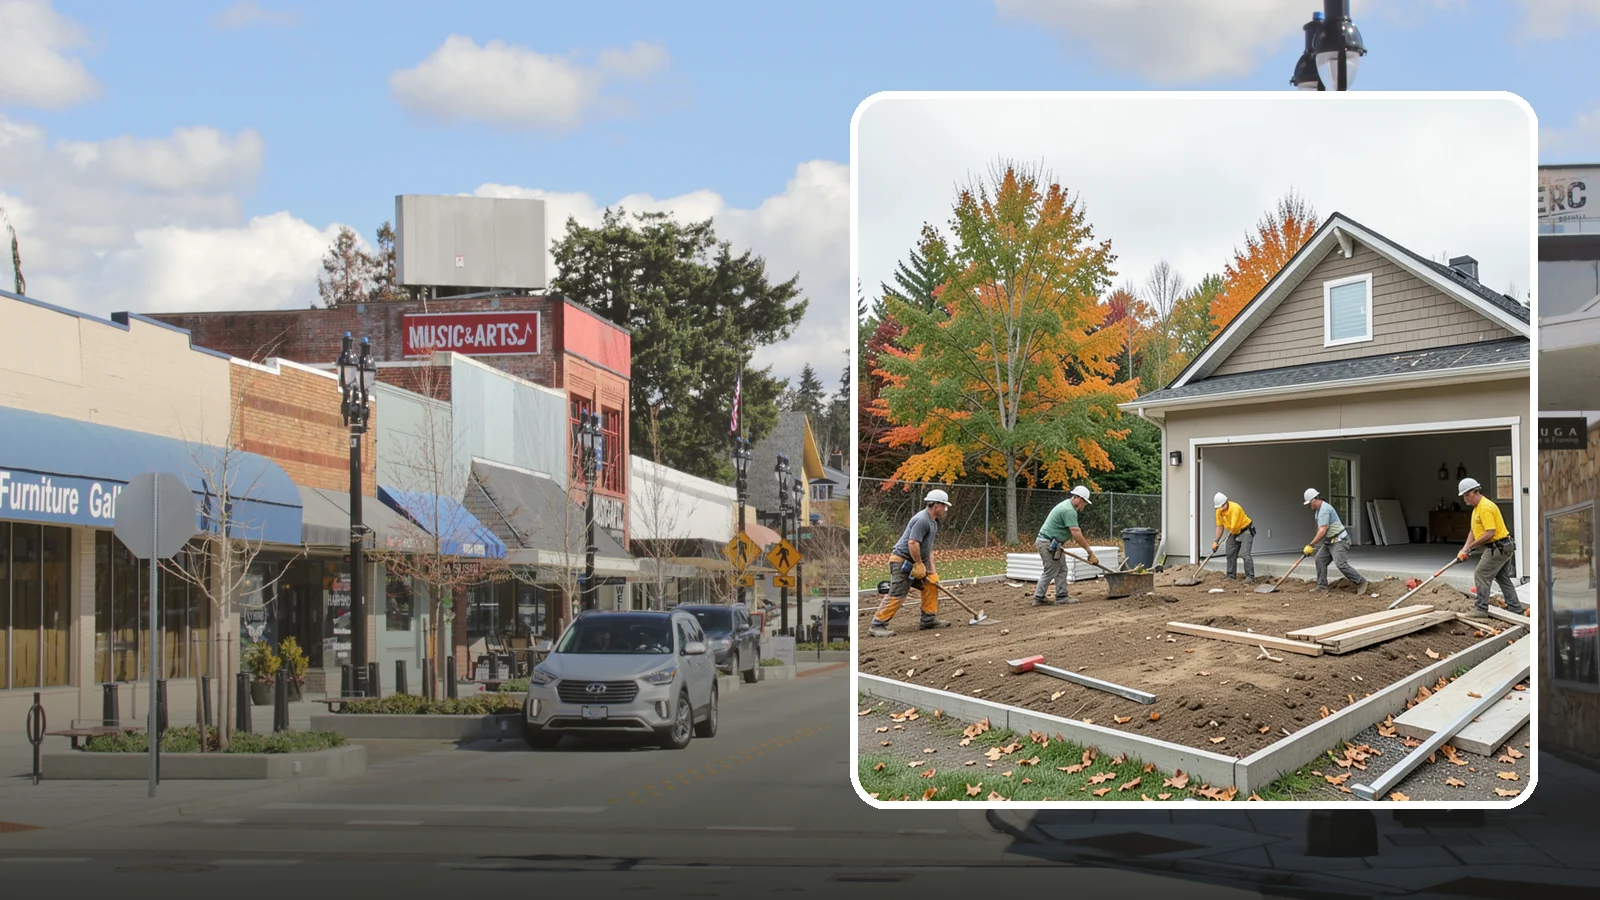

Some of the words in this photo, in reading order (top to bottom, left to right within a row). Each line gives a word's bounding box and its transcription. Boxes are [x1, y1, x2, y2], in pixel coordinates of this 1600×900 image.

[409, 323, 519, 349] MUSIC&ARTS
[0, 471, 79, 515] Furniture
[89, 482, 121, 519] Gal
